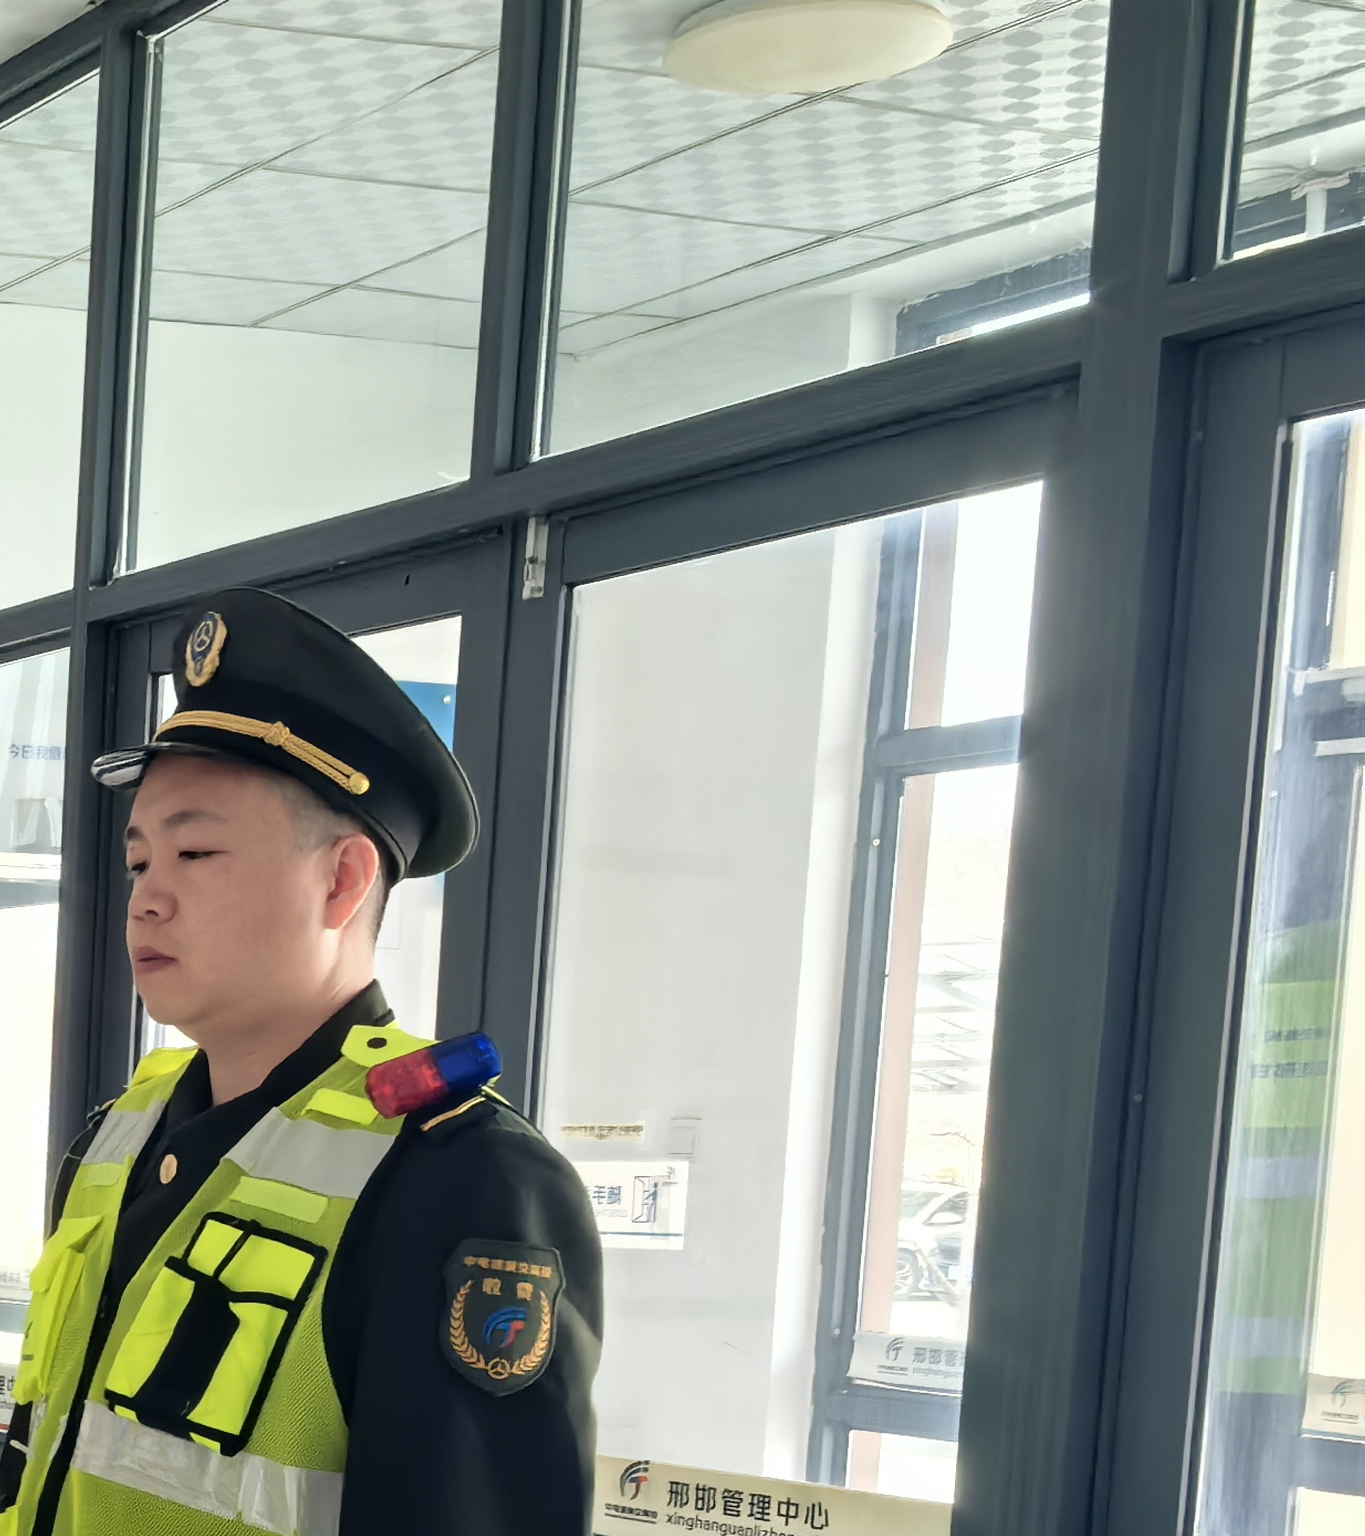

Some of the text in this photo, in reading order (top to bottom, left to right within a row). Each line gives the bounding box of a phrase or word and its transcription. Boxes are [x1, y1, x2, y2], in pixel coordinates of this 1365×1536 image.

[666, 1480, 831, 1531] 邢邯管理中心
